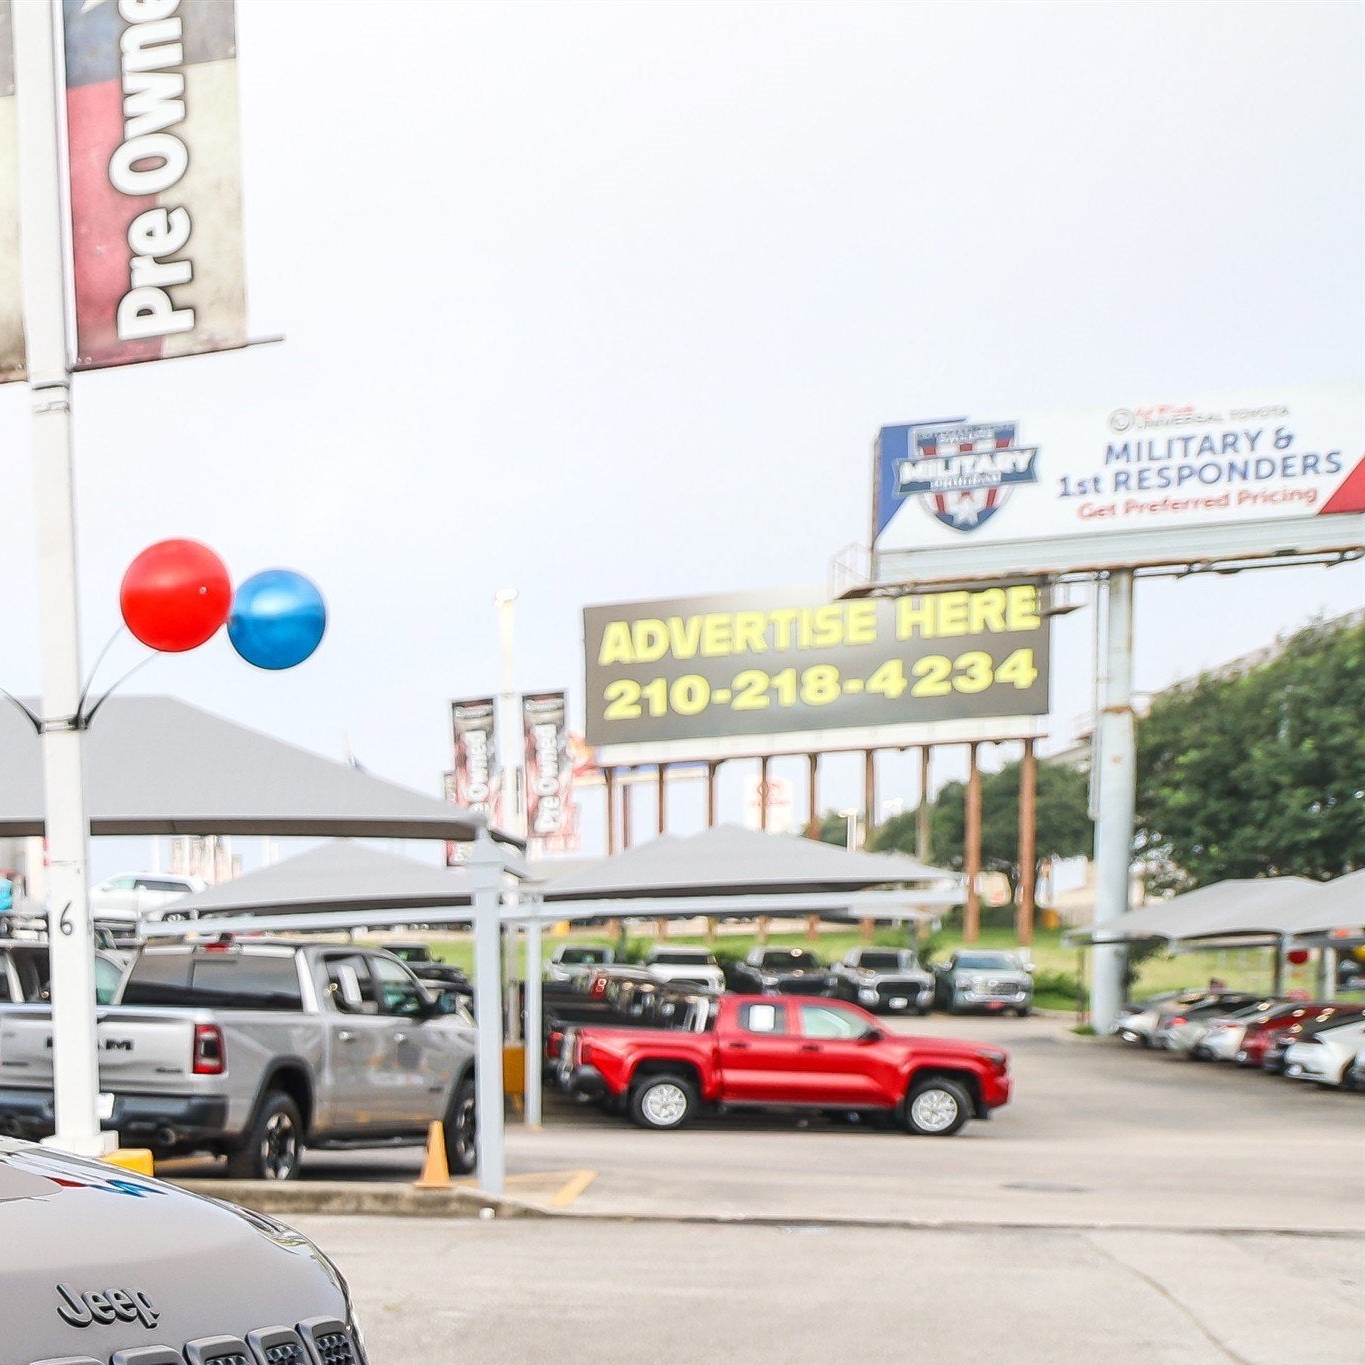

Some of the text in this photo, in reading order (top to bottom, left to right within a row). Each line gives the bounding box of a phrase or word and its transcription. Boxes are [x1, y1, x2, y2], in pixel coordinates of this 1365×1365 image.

[117, 206, 195, 340] Pre
[899, 450, 1036, 484] MILITARY
[1104, 426, 1296, 465] MILITARY &
[1059, 450, 1344, 498] 1st RESPONDERS
[1124, 493, 1229, 515] Preferred
[1238, 487, 1318, 507] Pricing
[598, 585, 1044, 666] ADVERTISE HERE
[603, 647, 1039, 721] 210-218-4234
[59, 900, 73, 936] 6
[56, 1282, 161, 1329] Jeep
